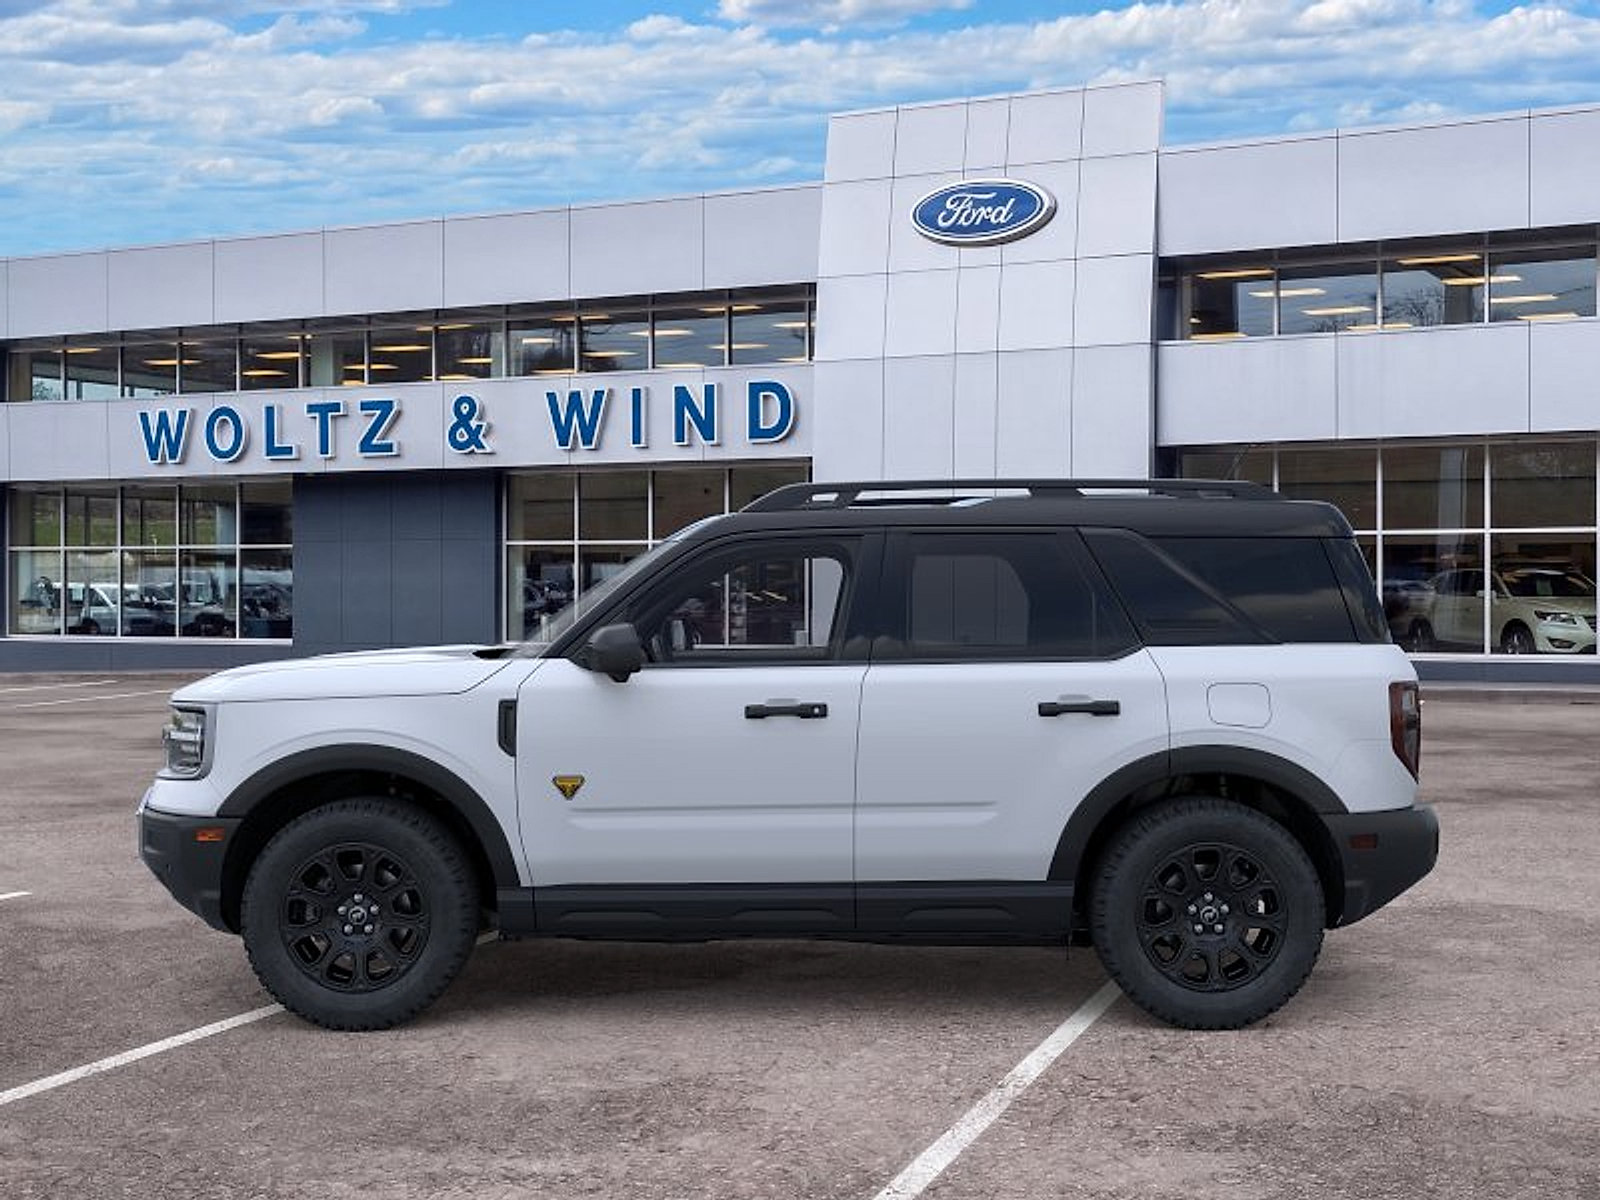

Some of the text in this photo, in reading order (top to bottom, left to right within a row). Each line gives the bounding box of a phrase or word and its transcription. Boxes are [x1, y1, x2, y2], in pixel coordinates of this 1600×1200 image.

[938, 192, 1015, 227] Ford
[138, 380, 795, 464] WOLTZ & WIND
